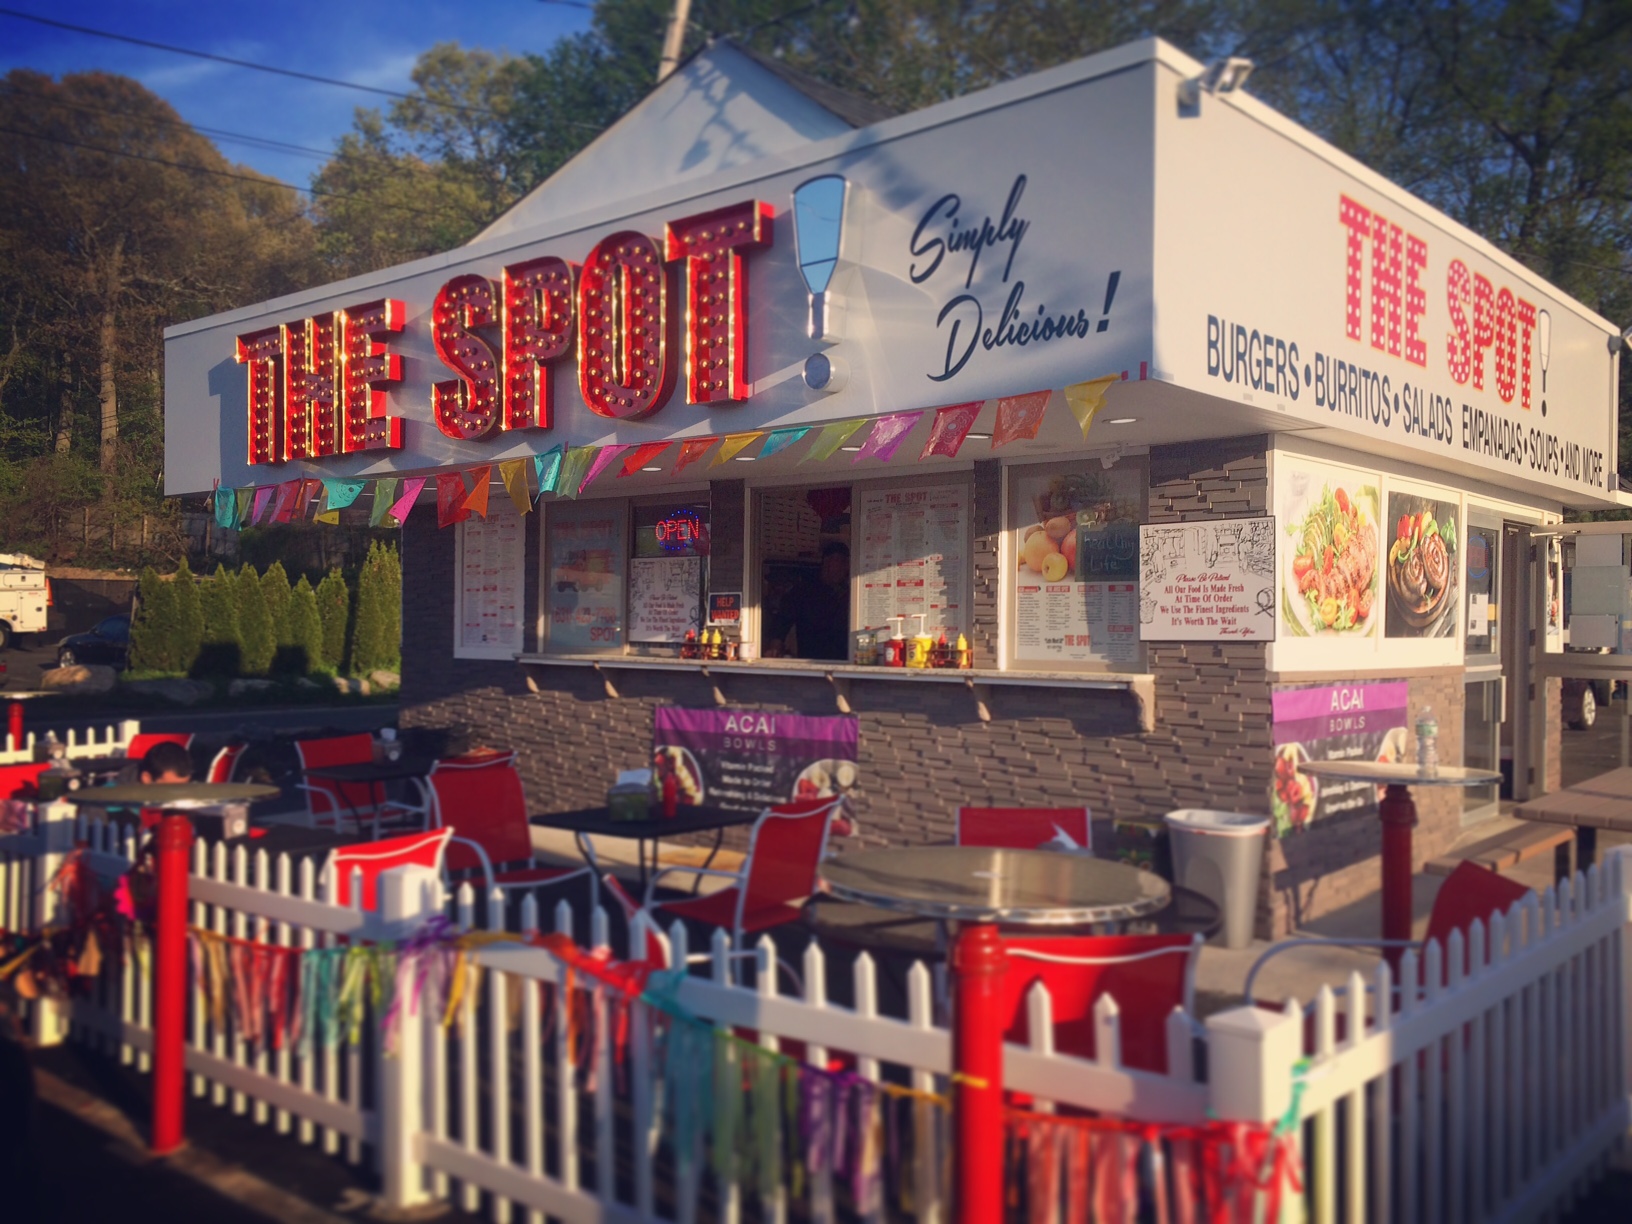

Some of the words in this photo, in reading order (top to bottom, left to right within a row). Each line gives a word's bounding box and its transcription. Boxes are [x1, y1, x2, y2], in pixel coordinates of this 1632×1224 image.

[909, 173, 1030, 289] Simply
[1339, 192, 1428, 368] THE
[1445, 258, 1537, 411] SPOT
[234, 297, 406, 466] THE
[431, 199, 774, 441] SPOT
[926, 271, 1122, 382] Delicious!
[1207, 313, 1300, 401] BURGERS
[1315, 351, 1391, 428] BURRITOS
[1402, 381, 1453, 446] SALADS
[1462, 403, 1523, 466] EMPANADAS
[1529, 427, 1559, 476] SOUPS
[1565, 440, 1581, 482] AND
[1582, 446, 1603, 488] MORE
[885, 493, 901, 503] THE
[904, 491, 928, 502] SPOT
[655, 518, 700, 541] OPEN
[1175, 573, 1196, 583] Please
[1197, 572, 1208, 582] Be
[1208, 572, 1231, 582] Patient
[1164, 585, 1173, 594] All
[1175, 585, 1186, 594] Our
[1188, 584, 1201, 593] Food
[1203, 584, 1208, 593] Is
[1210, 584, 1226, 593] Made
[1228, 583, 1244, 592] Fresh
[717, 597, 734, 607] HELP
[1175, 595, 1182, 603] At
[1184, 594, 1200, 603] Time
[1202, 594, 1212, 603] Of
[1213, 593, 1233, 603] Order
[711, 609, 740, 620] WANTED
[1160, 605, 1169, 614] We
[1171, 606, 1181, 614] Use
[1183, 605, 1193, 614] The
[1195, 605, 1214, 614] Finest
[1215, 604, 1249, 615] Ingredients
[1171, 617, 1182, 626] It's
[1184, 617, 1204, 626] Worth
[1206, 617, 1218, 625] The
[1220, 616, 1236, 625] Wait
[590, 626, 617, 642] SPOT
[1064, 634, 1074, 646] THE
[1076, 634, 1091, 646] SPOT
[1331, 688, 1365, 711] ACAI
[724, 715, 776, 734] ACAI
[1330, 716, 1366, 732] BOWLS
[723, 737, 777, 751] BOWLS
